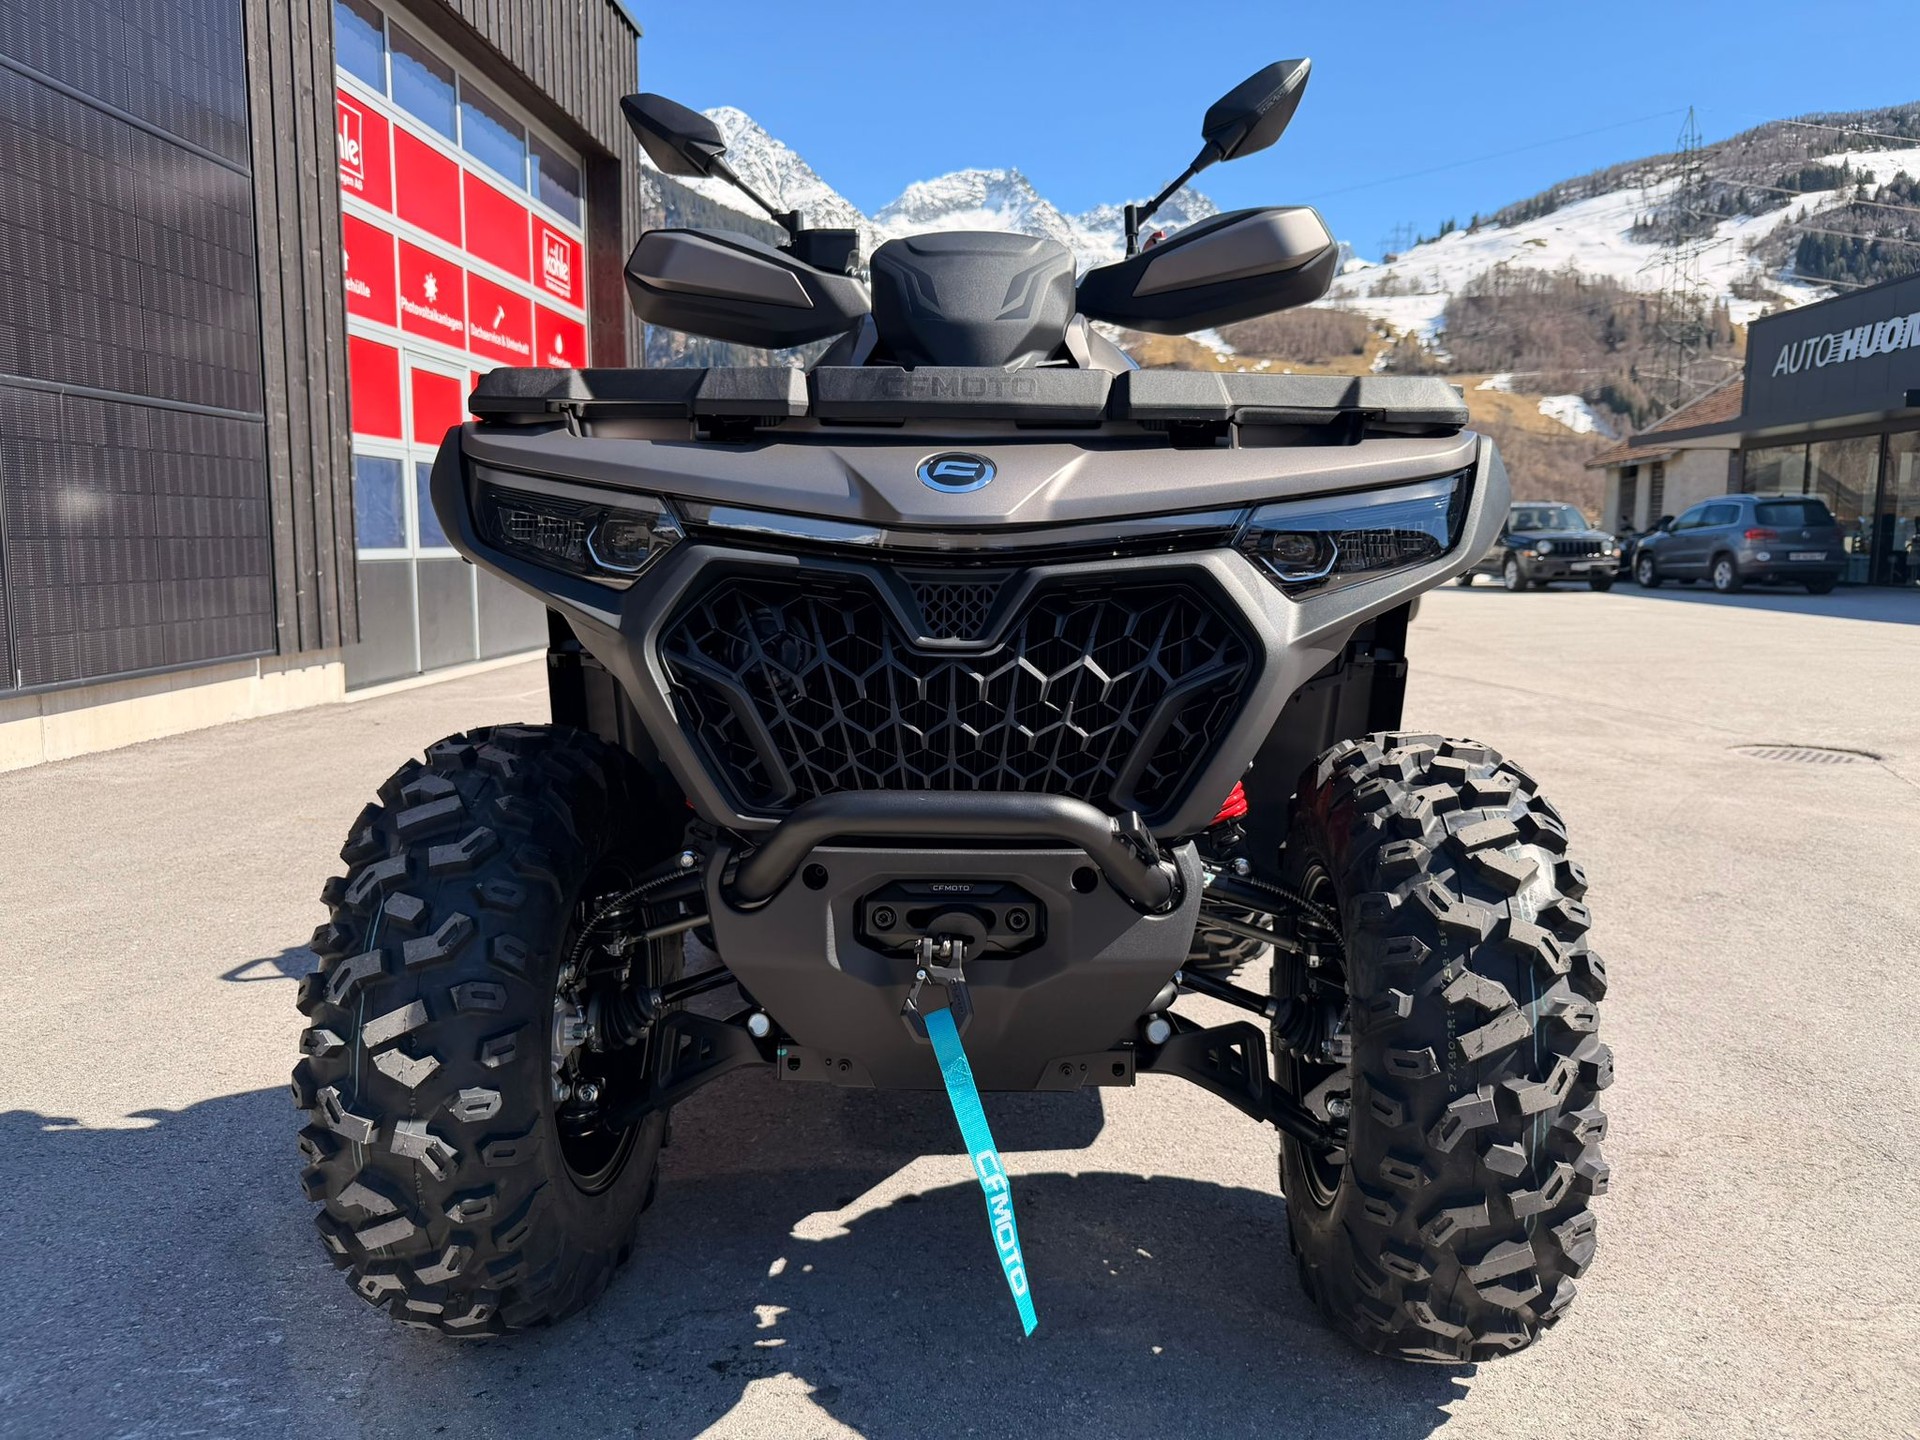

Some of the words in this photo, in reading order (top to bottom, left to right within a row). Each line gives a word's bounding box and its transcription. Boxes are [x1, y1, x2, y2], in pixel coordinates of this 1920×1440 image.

[400, 296, 463, 332] Photovoltaikanlagen
[877, 376, 1038, 397] CFMOTO
[976, 1150, 1027, 1297] CFMOTO
